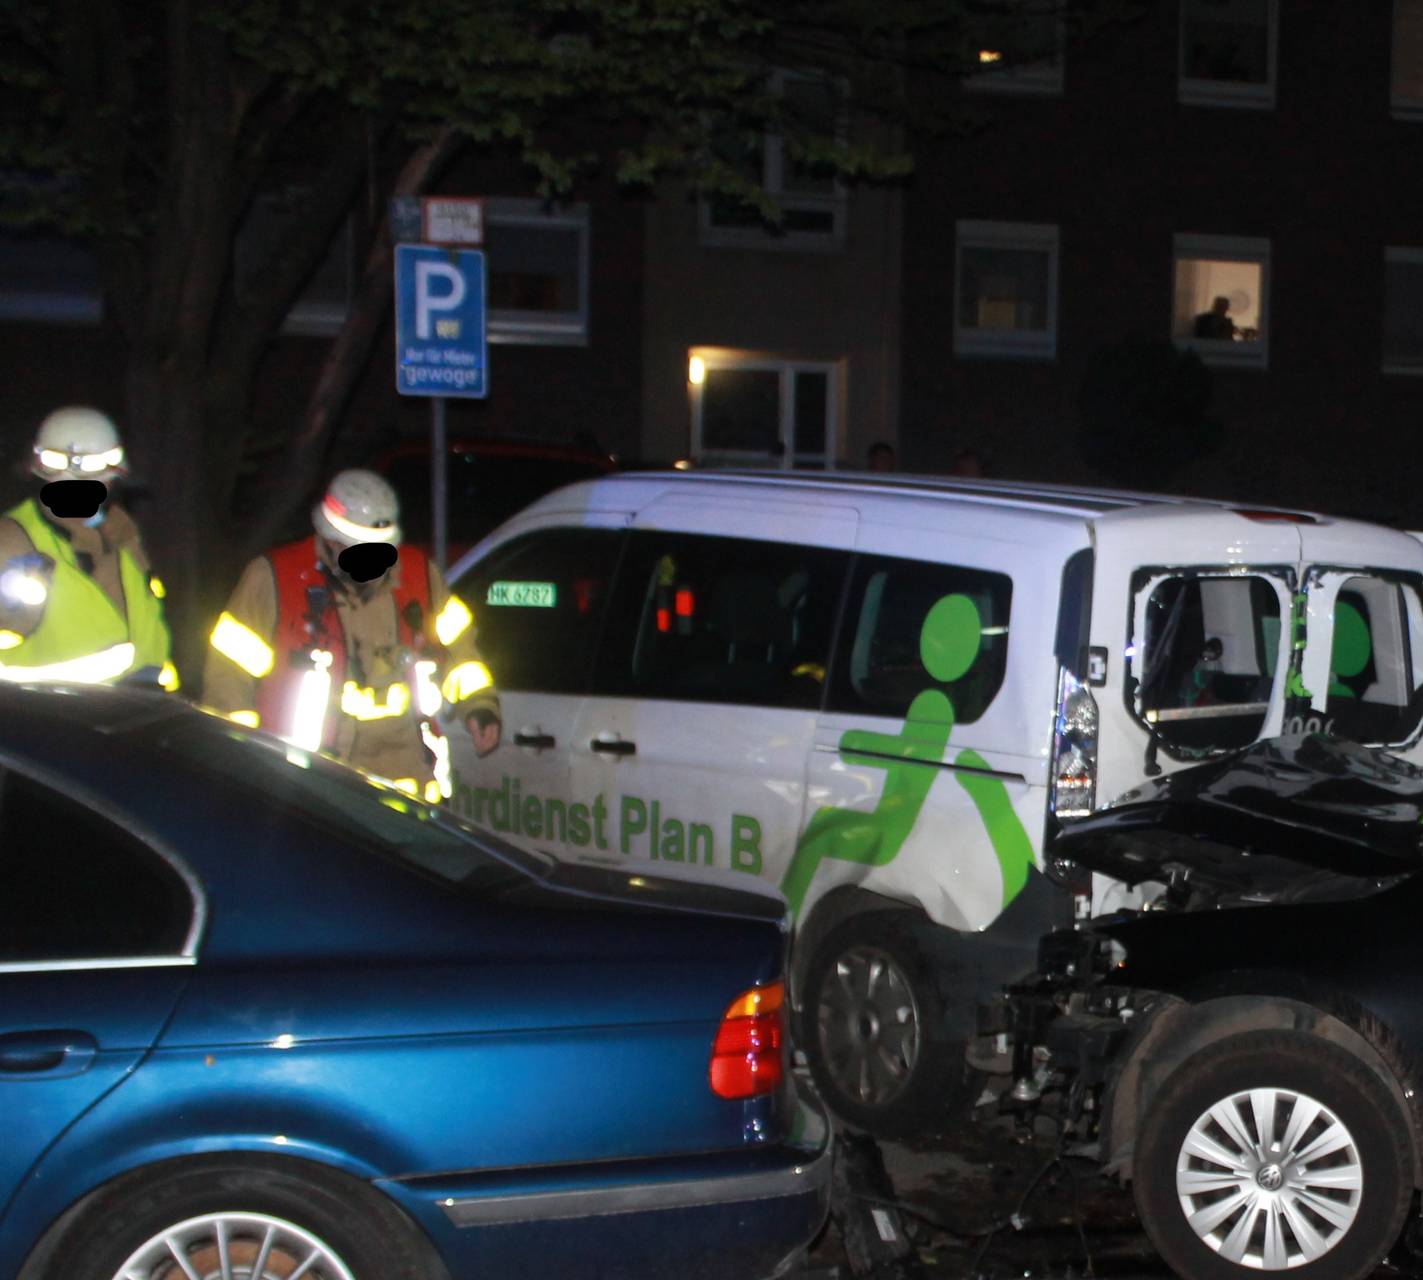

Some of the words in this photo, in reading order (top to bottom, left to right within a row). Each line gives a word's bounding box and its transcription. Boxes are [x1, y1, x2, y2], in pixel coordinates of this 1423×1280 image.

[415, 261, 465, 340] P
[405, 367, 477, 388] gewoge
[449, 767, 609, 850] hrdienst
[620, 794, 714, 865] Plan
[731, 814, 763, 876] B
